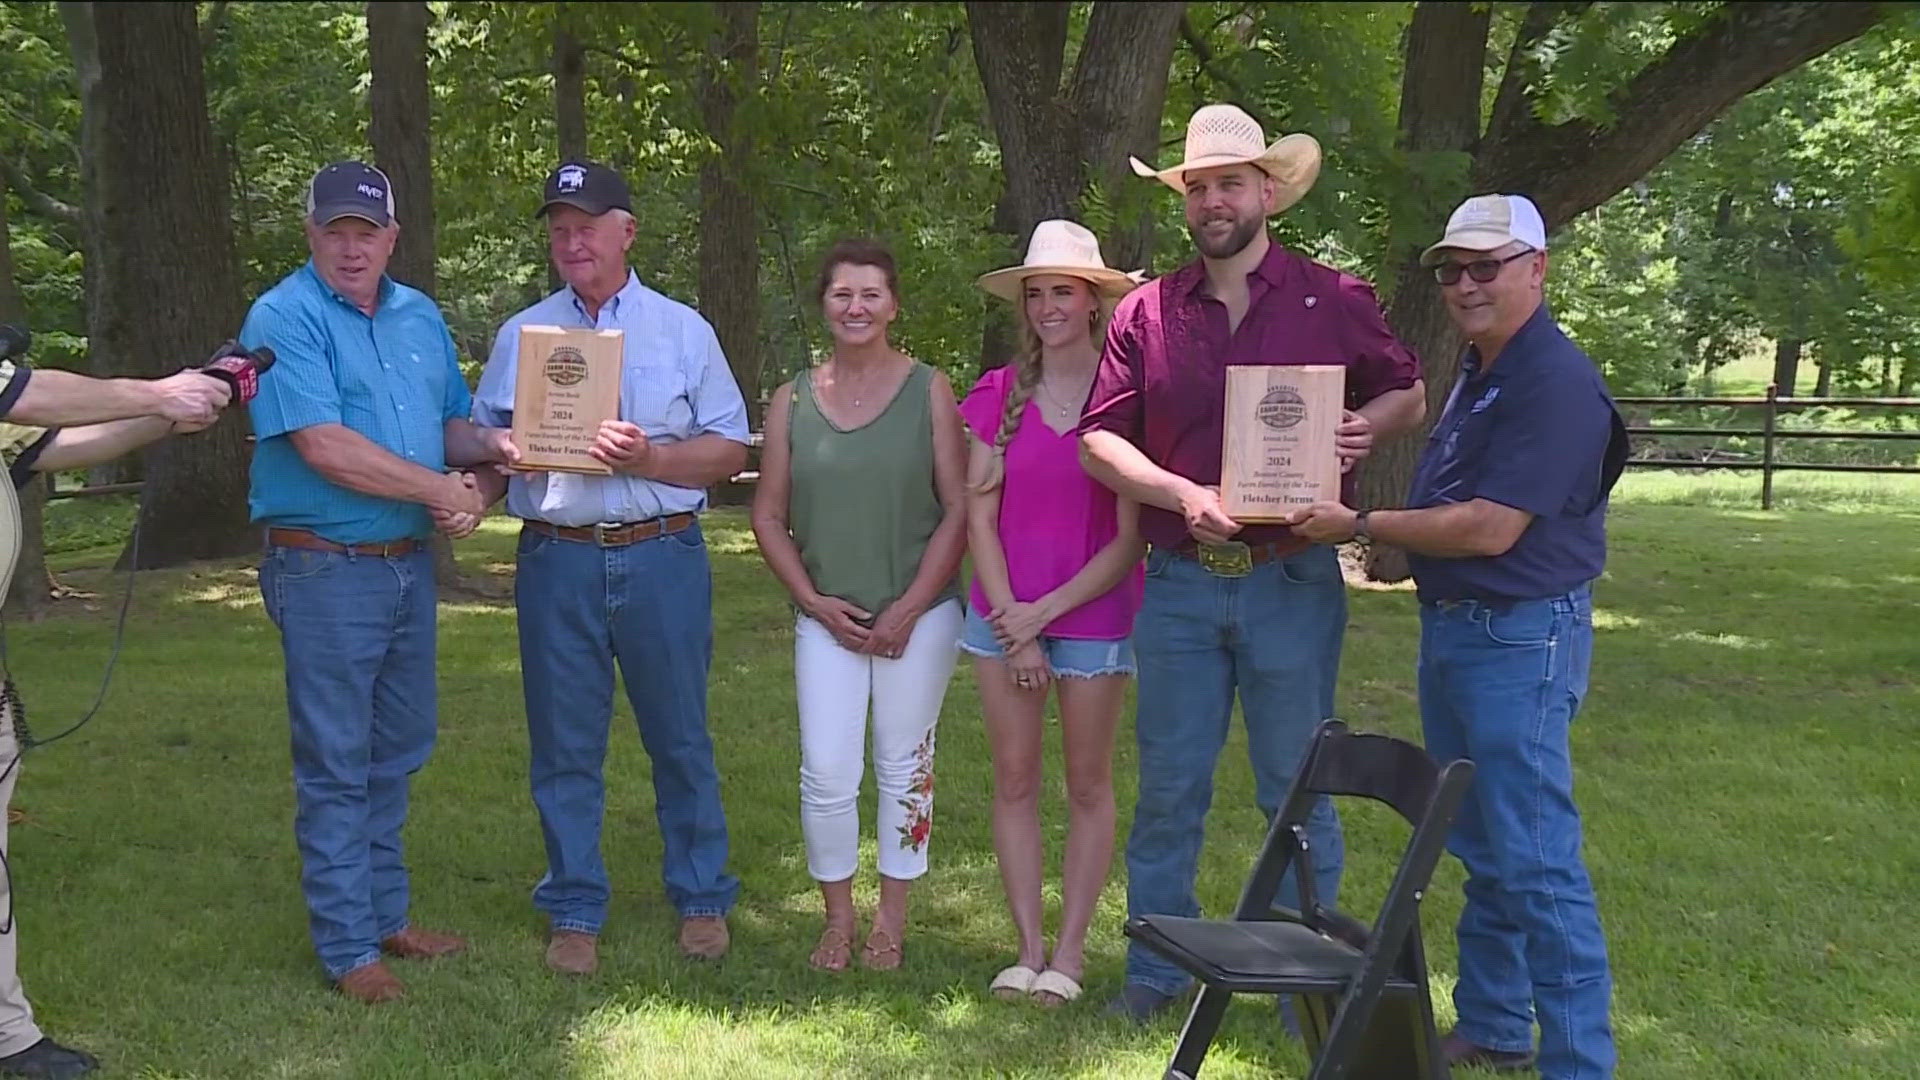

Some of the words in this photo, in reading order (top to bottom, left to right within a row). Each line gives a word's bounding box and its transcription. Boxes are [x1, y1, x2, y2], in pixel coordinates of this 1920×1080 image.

[1260, 405, 1279, 414] FARM
[552, 411, 573, 420] 2024
[562, 424, 583, 432] County
[528, 444, 562, 454] Fletcher
[1266, 457, 1291, 466] 2024
[1280, 472, 1304, 480] County
[1282, 482, 1290, 490] of
[1242, 494, 1281, 504] Fletcher
[1283, 495, 1314, 504] Farms
